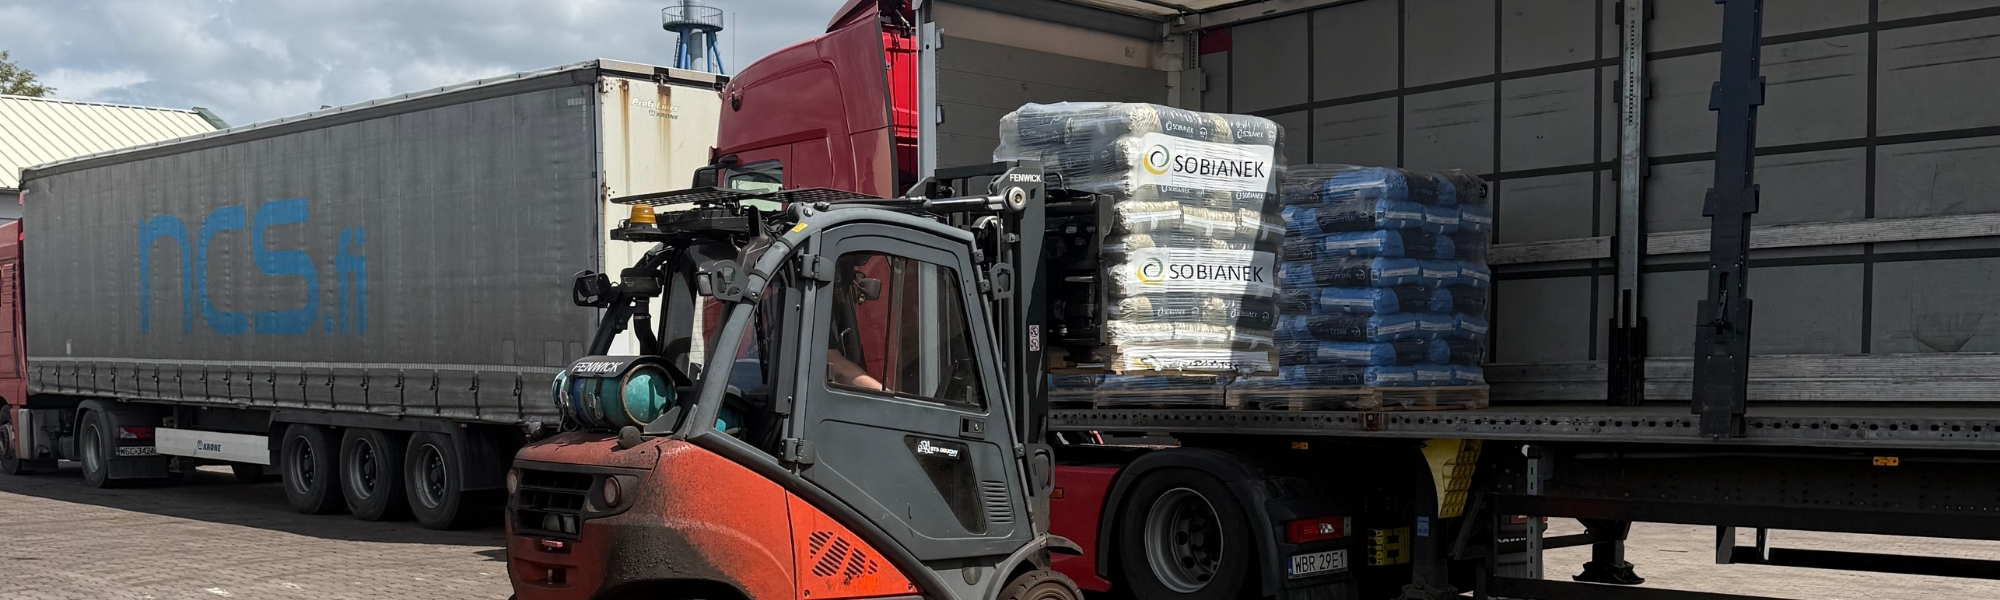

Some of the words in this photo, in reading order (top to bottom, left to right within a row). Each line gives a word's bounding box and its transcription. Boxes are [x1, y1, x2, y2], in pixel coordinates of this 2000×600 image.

[631, 98, 654, 108] Profi
[656, 112, 679, 120] KRONE
[1173, 154, 1265, 178] SOBIANEK
[1010, 173, 1042, 183] FENWICK
[138, 198, 367, 335] ncs.fi
[1169, 263, 1263, 283] SOBIANEK
[571, 361, 624, 373] FENWICK
[203, 442, 221, 452] KRONE
[1294, 555, 1316, 574] WBR
[1319, 552, 1344, 571] 29E1
